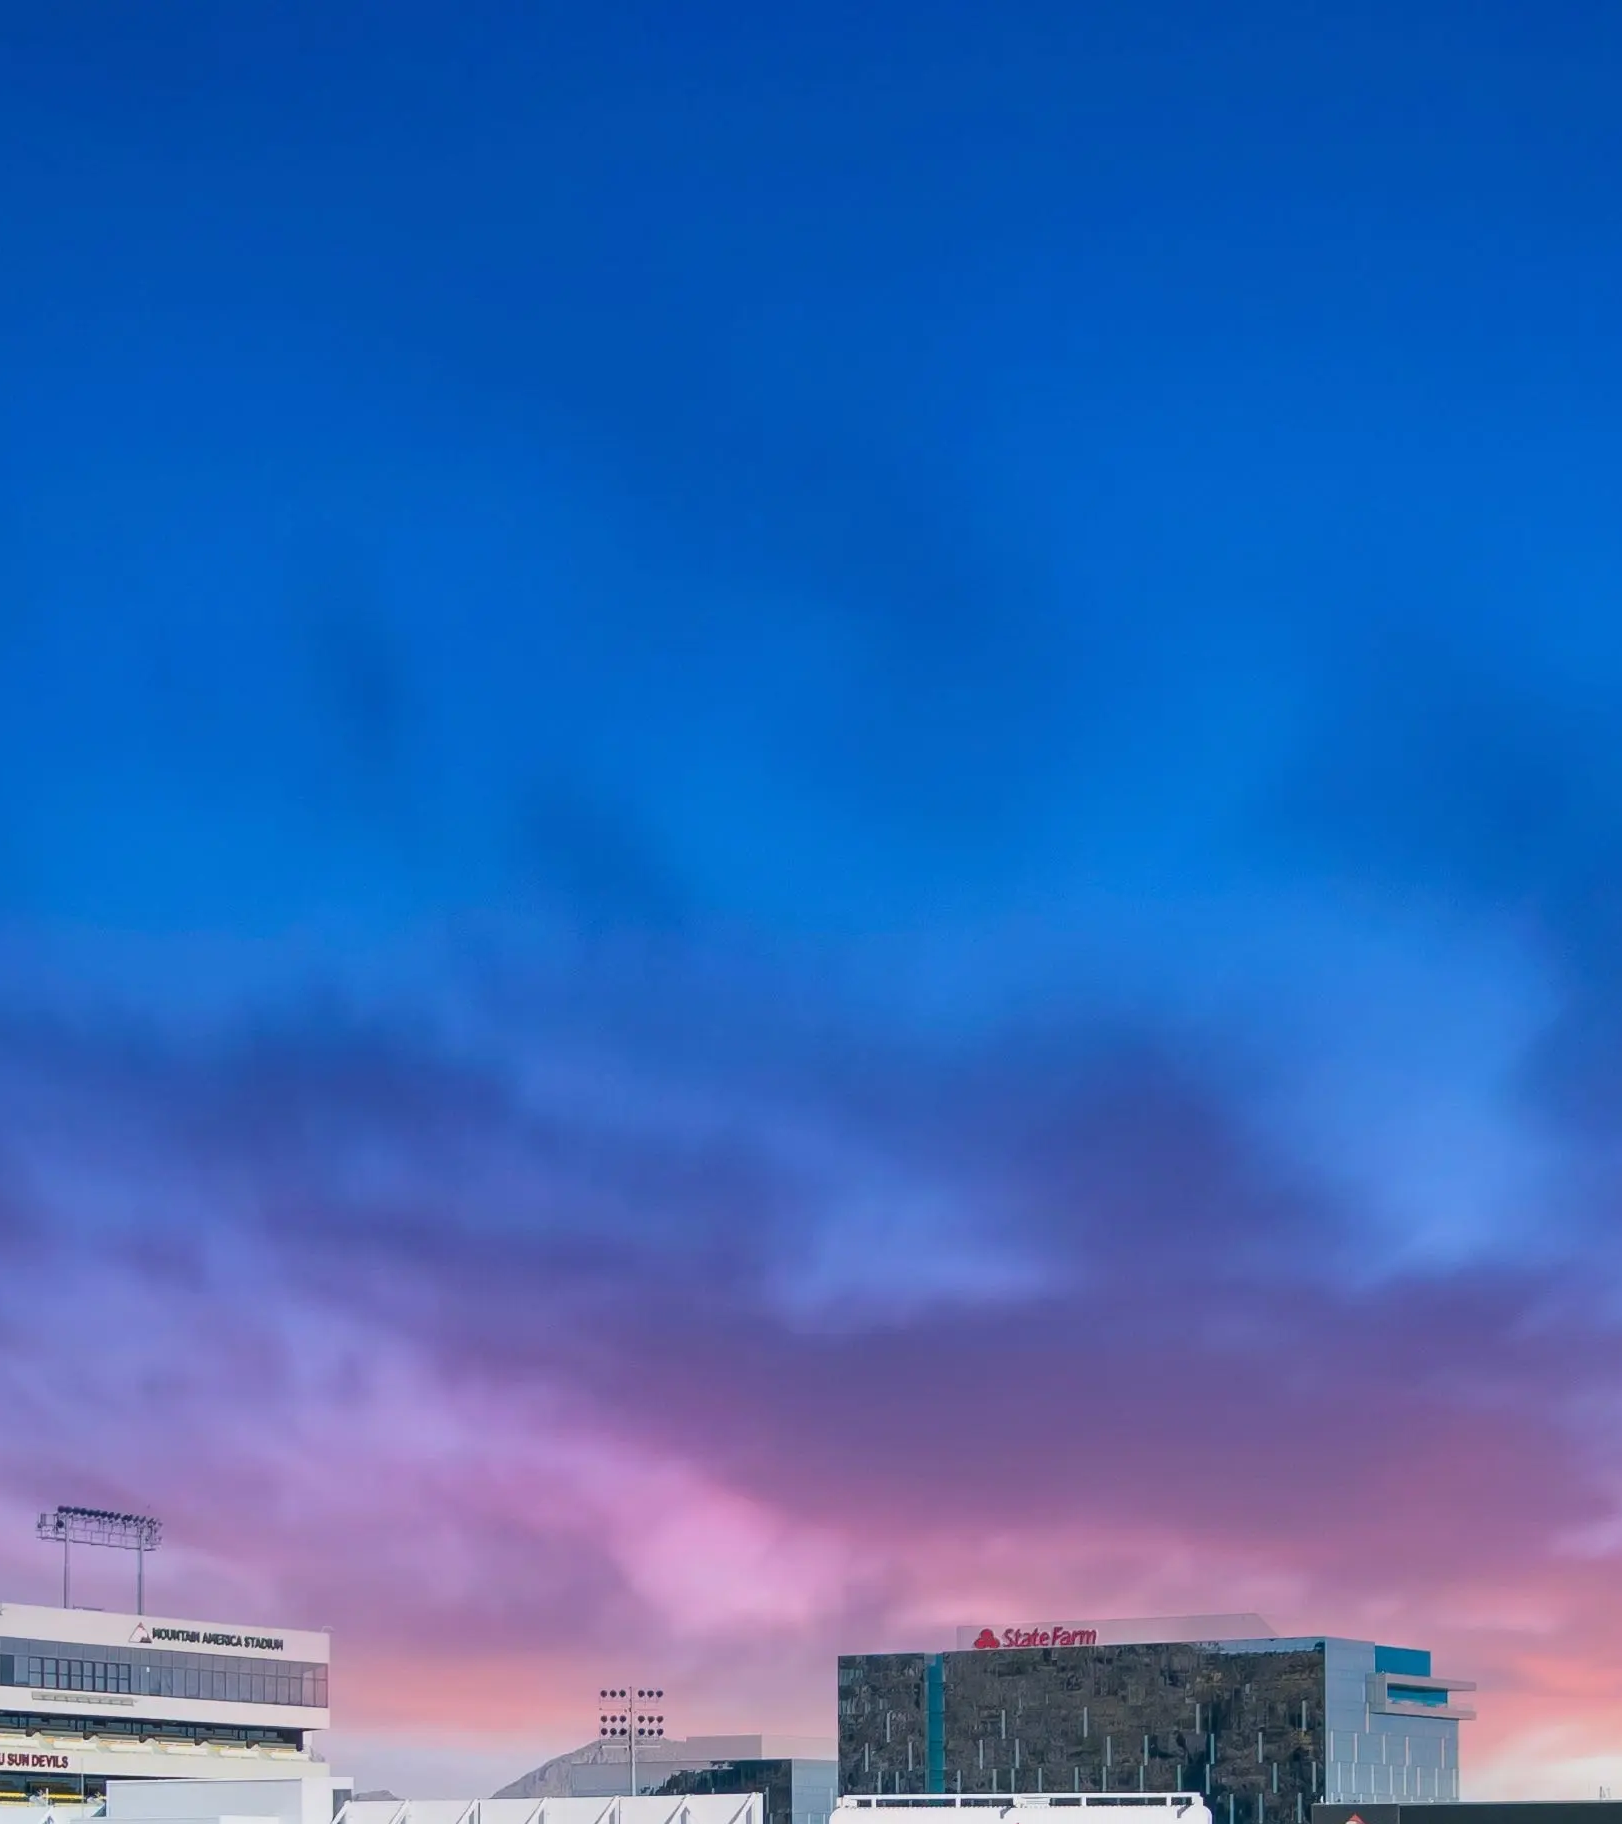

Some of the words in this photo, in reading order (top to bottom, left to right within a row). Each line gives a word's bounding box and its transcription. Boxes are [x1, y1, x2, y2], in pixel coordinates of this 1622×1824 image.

[152, 1627, 200, 1643] MOUNTAIN
[202, 1632, 243, 1647] AMERICA
[244, 1636, 284, 1651] STADIUM
[7, 1752, 29, 1767] SUN
[31, 1753, 69, 1769] DEVILS
